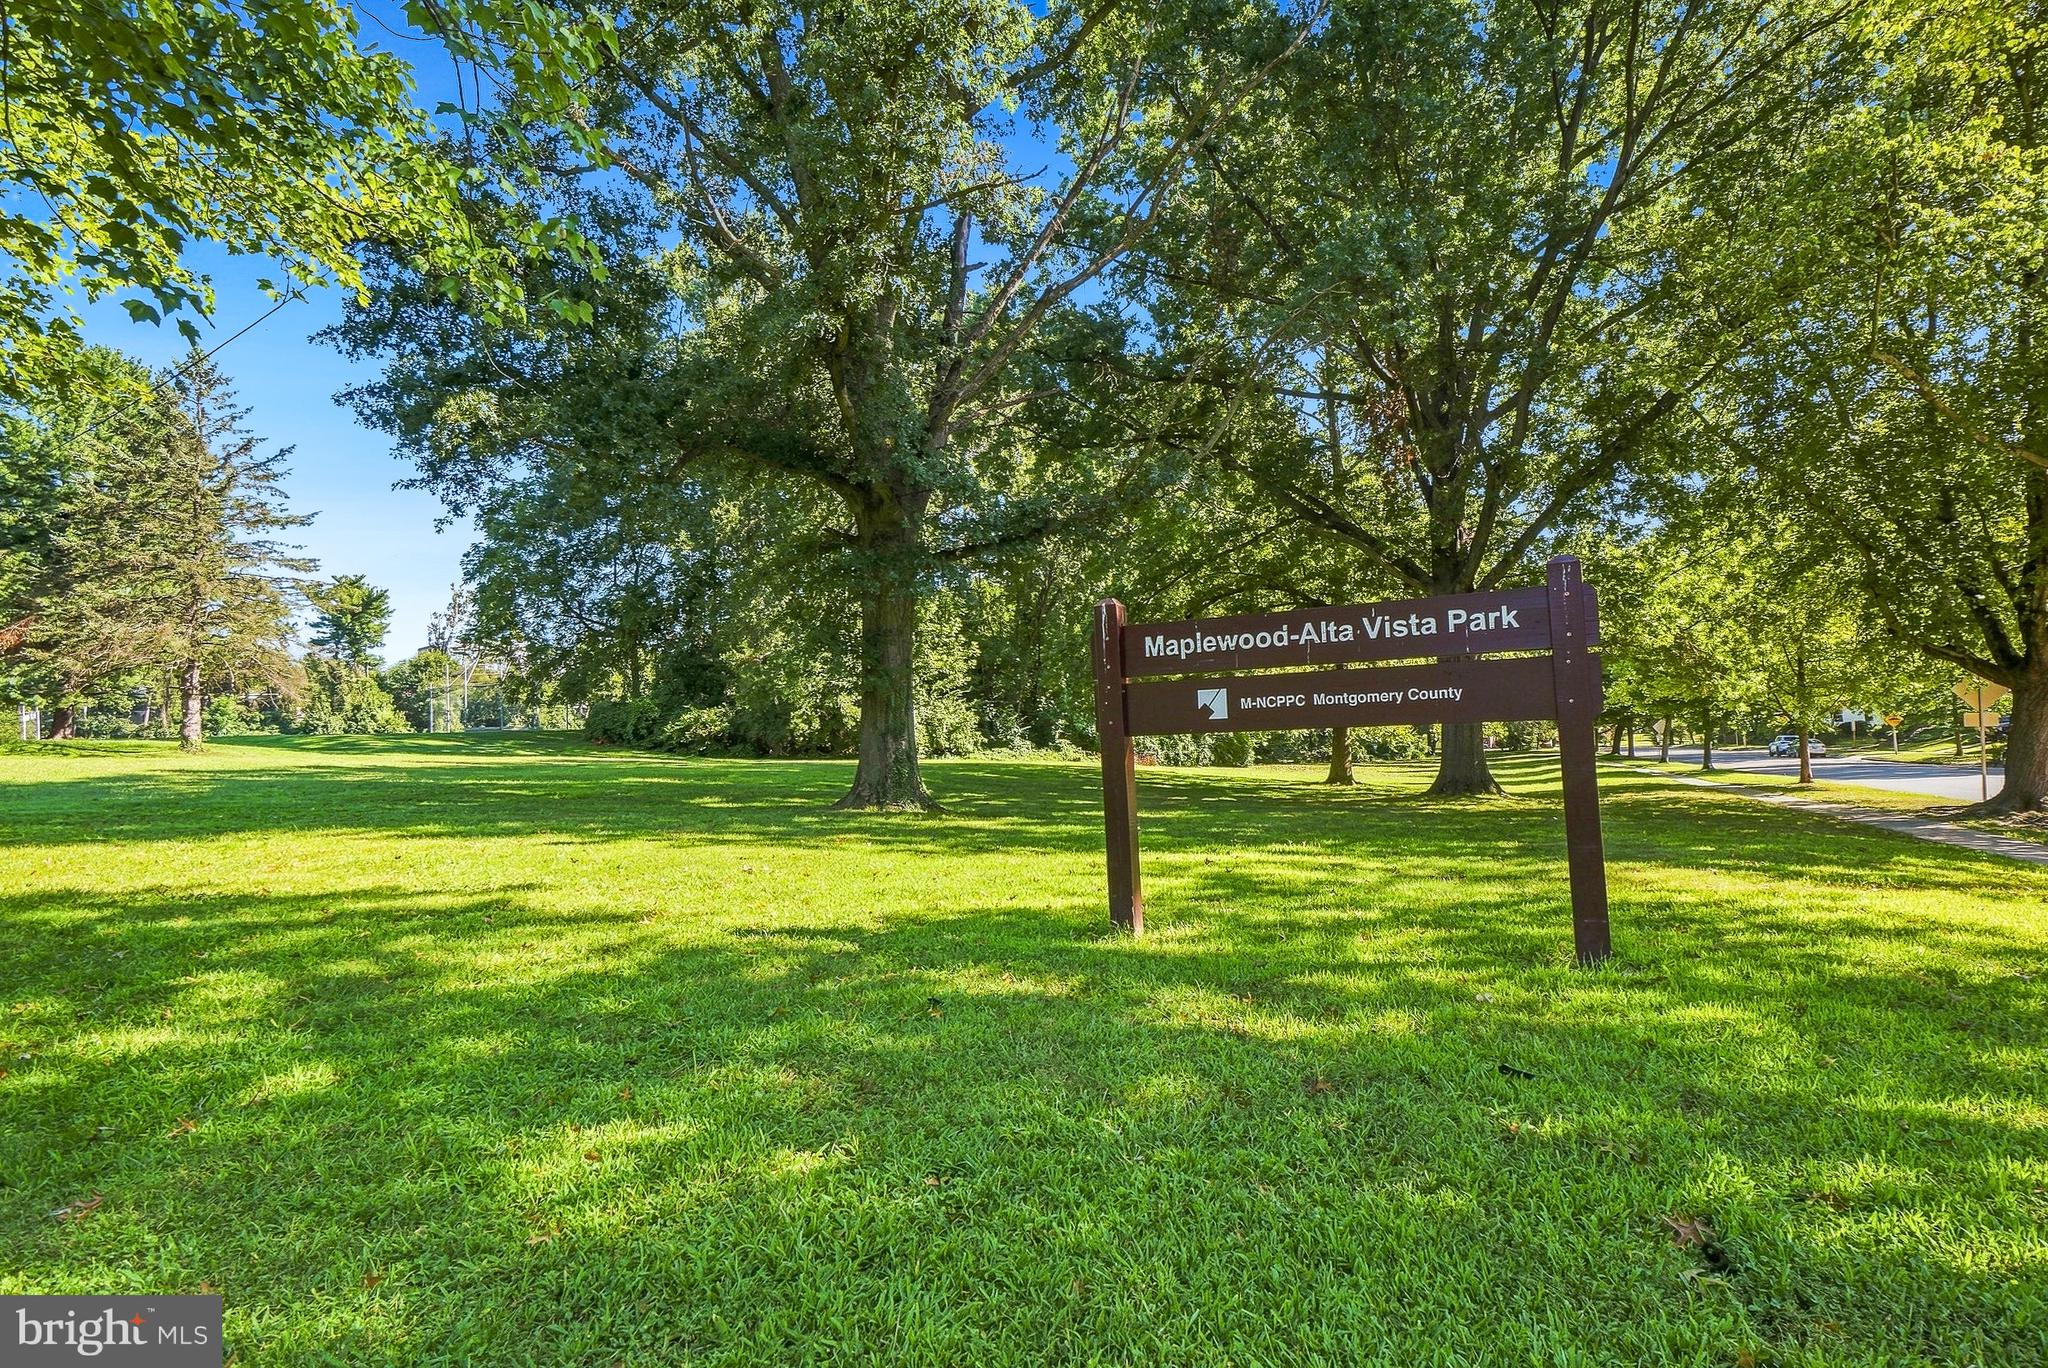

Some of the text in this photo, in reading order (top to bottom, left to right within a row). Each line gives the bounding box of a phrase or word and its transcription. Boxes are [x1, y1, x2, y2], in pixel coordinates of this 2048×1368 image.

[1144, 604, 1520, 660] Maplewood-Alta Vista Park
[1240, 685, 1463, 711] M-NCPPC Montgomery County
